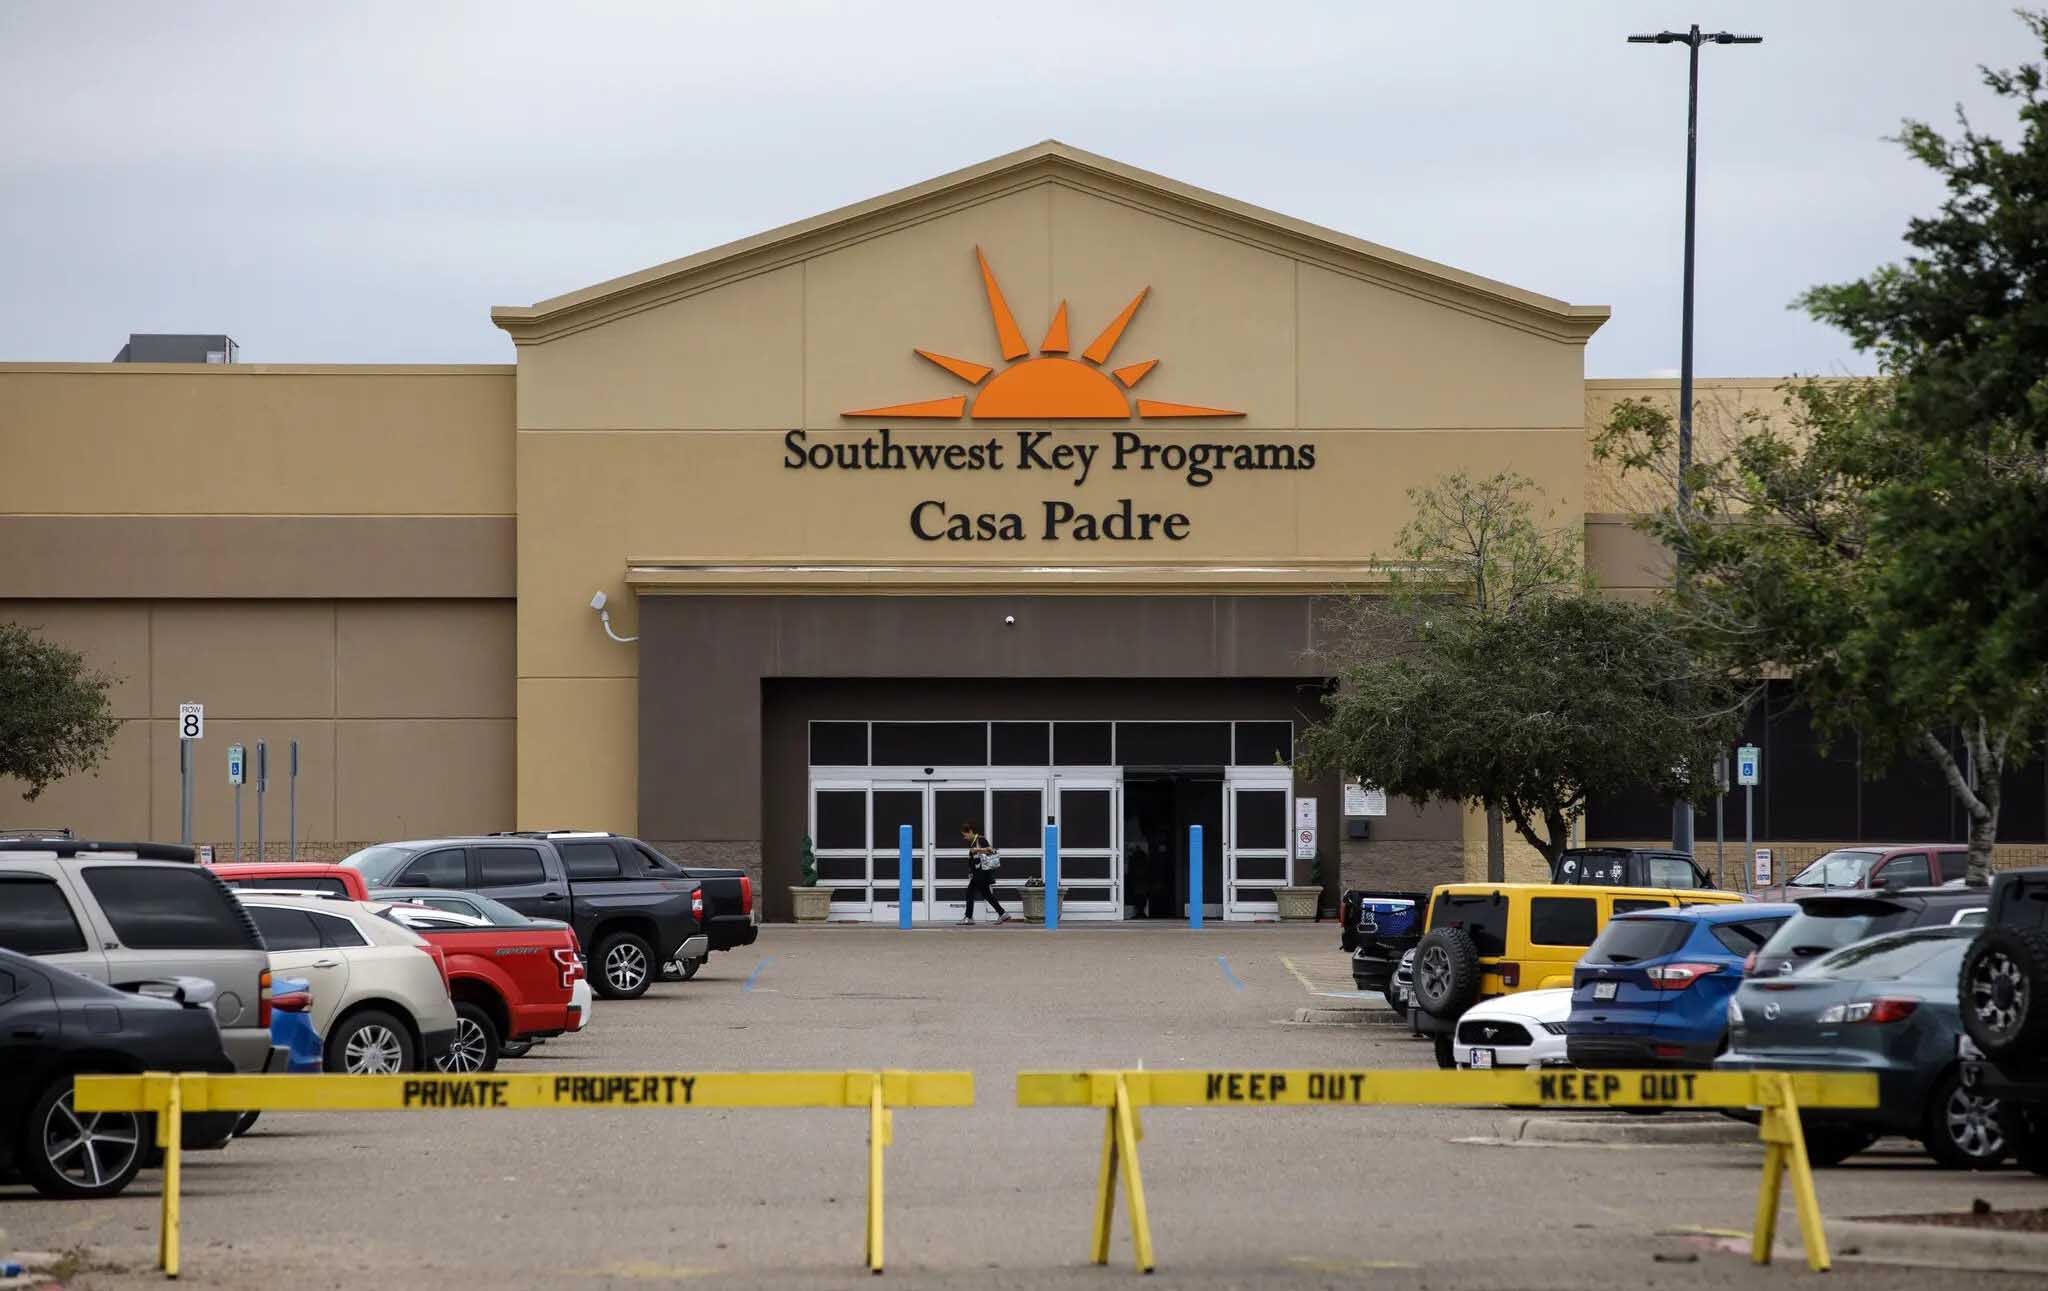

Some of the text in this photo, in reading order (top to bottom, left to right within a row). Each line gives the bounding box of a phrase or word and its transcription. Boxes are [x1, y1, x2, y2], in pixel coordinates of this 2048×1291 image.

[784, 429, 1315, 486] Southwest Key Programs
[909, 500, 1191, 541] Casa Padre
[184, 714, 199, 736] 8
[403, 1076, 696, 1107] PRIVATE PROPERTY
[1207, 1073, 1365, 1101] KEEP OUT
[1539, 1074, 1697, 1100] KEEP OUT
